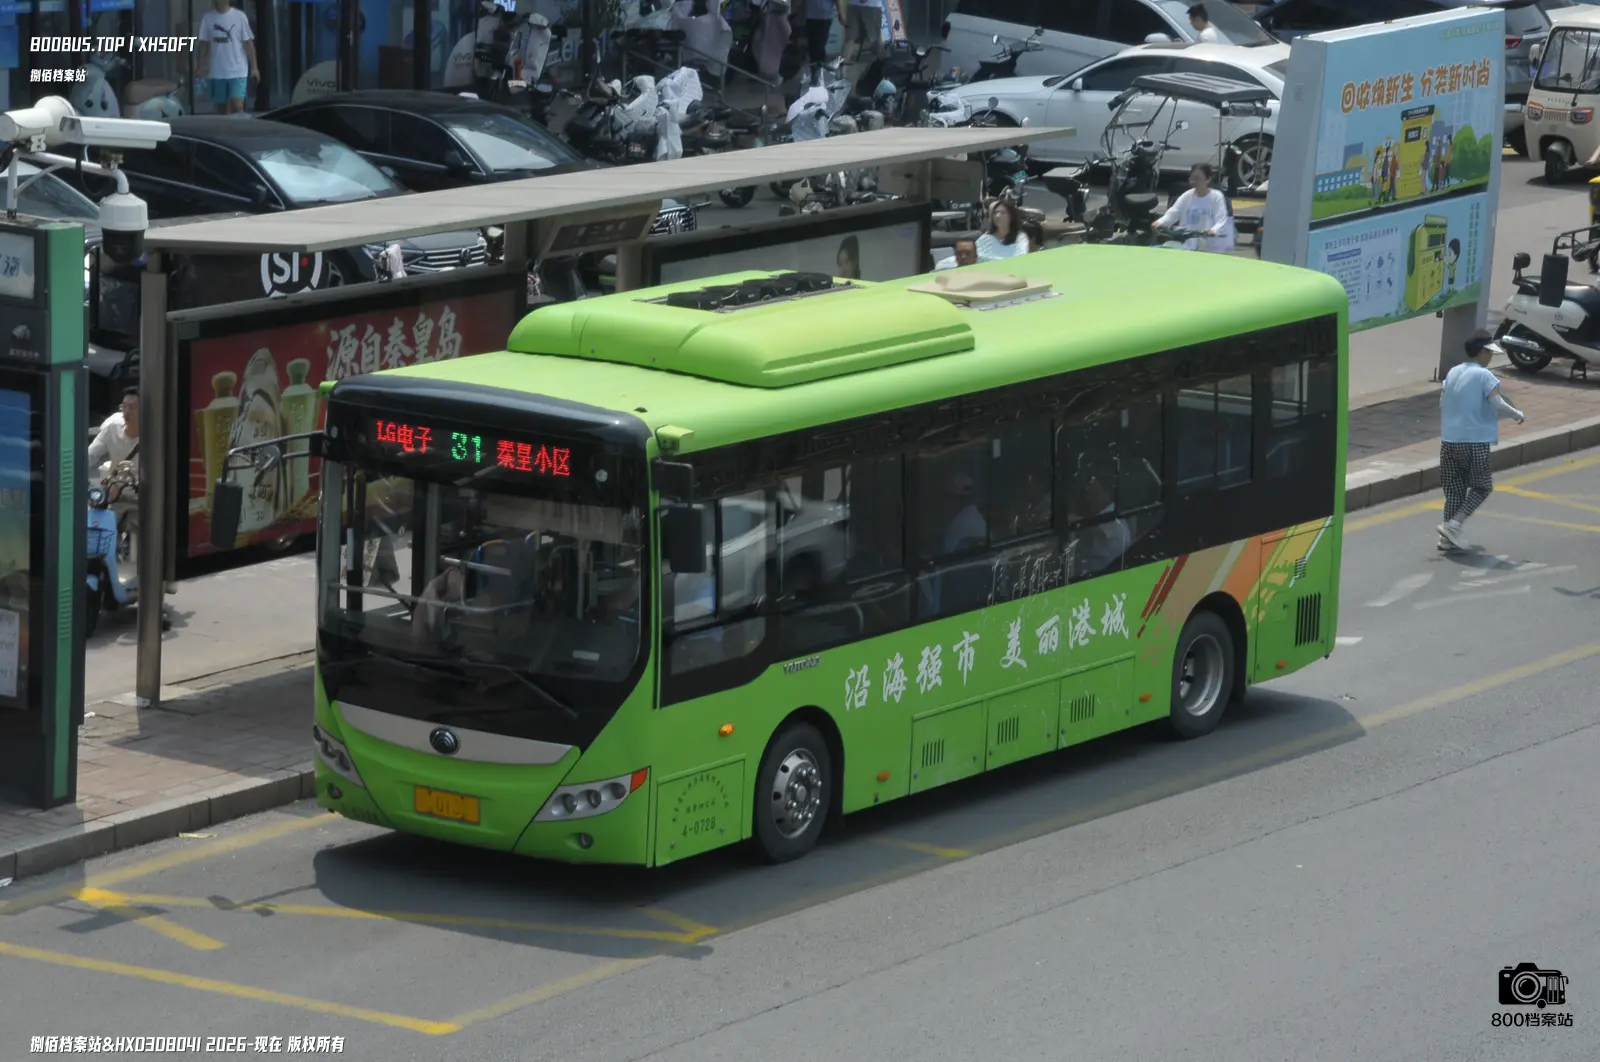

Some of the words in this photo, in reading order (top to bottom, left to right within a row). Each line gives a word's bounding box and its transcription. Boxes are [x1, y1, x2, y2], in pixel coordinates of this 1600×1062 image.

[1420, 58, 1491, 98] 分类新时尚
[326, 304, 463, 381] 源自秦皇岛
[376, 420, 433, 454] LG电子
[451, 431, 482, 463] 31
[496, 439, 571, 477] 秦皇小区
[844, 631, 980, 711] 沿海强市
[1001, 592, 1130, 669] 美丽港城
[681, 815, 717, 838] 4-0728
